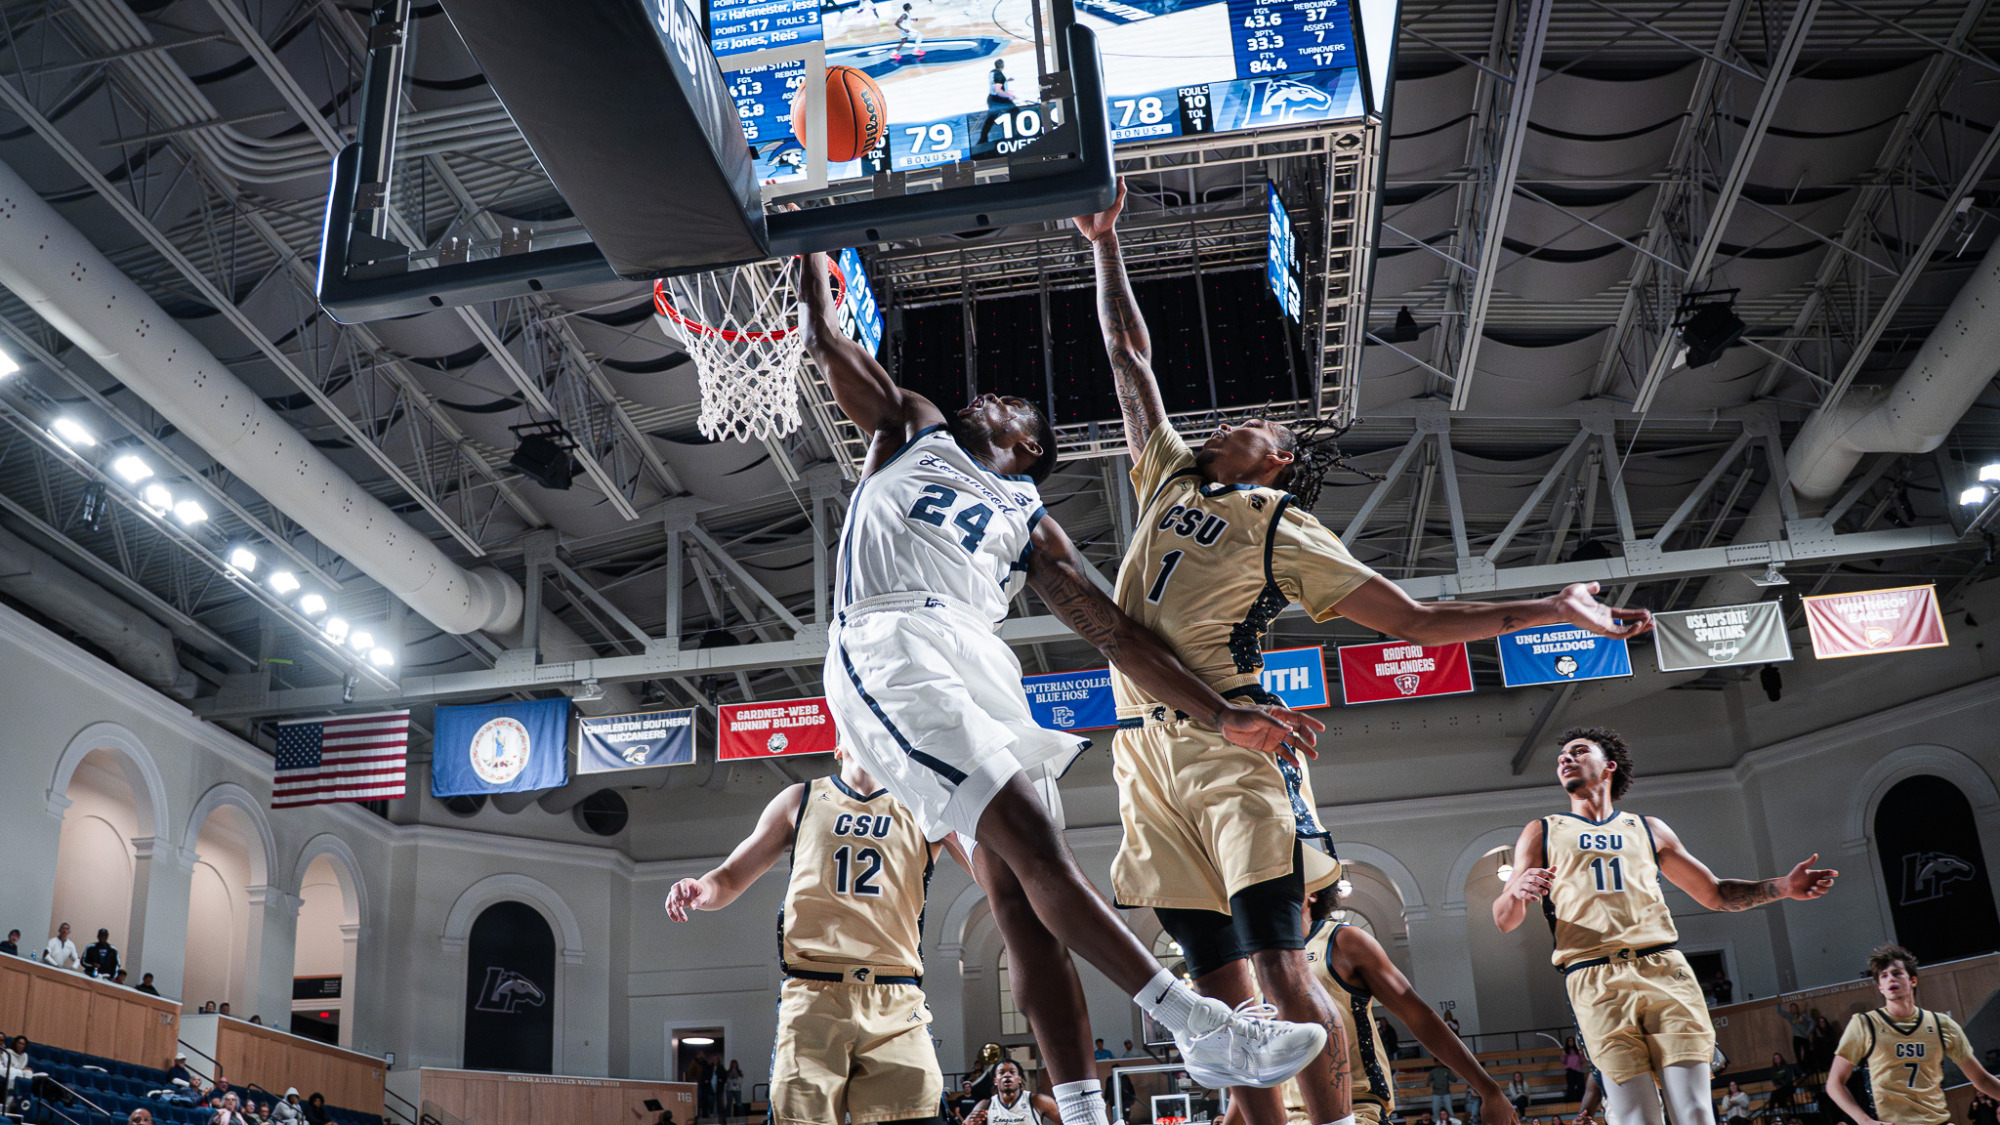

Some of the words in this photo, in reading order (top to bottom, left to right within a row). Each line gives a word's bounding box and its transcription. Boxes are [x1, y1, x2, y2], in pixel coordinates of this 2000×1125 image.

[714, 0, 743, 8] POINTS
[729, 3, 791, 20] Hafemeister,
[792, 0, 818, 12] Jesse
[1253, 7, 1270, 15] FG%
[1293, 0, 1337, 10] REBOUNDS
[1244, 13, 1282, 28] 43.6
[1305, 8, 1327, 21] 37
[715, 25, 747, 36] POINTS
[749, 19, 769, 32] 17
[776, 16, 805, 26] FOULS
[807, 11, 818, 24] 3
[1303, 22, 1334, 32] ASSISTS
[716, 42, 728, 50] 23
[731, 37, 768, 49] Jones,
[771, 30, 798, 42] Reis
[1247, 35, 1284, 51] 33.3
[1314, 31, 1325, 43] 7
[1298, 44, 1345, 55] TURNOVERS
[1249, 58, 1287, 73] 84.4
[1312, 53, 1334, 66] 17
[775, 69, 806, 79] REBOUN
[1178, 86, 1209, 97] FOULS
[1184, 96, 1206, 109] 10
[739, 104, 764, 118] 6.8
[1114, 97, 1164, 127] 78
[1187, 109, 1206, 118] TOL
[861, 90, 878, 153] Wilson
[1192, 119, 1202, 131] 1
[905, 124, 953, 154] 79
[867, 150, 885, 160] TOL
[871, 158, 881, 171] 1
[906, 484, 994, 555] 24
[1158, 504, 1229, 548] CSU
[1146, 549, 1185, 606] 1
[1834, 597, 1908, 615] WINTHROP
[1685, 614, 1707, 629] USC
[1706, 610, 1749, 627] UPSTATE
[1848, 609, 1900, 623] EAGLES
[1515, 633, 1541, 645] UNC
[1694, 625, 1746, 642] SPARTANS
[1382, 645, 1424, 661] RADFORD
[1532, 639, 1595, 655] BULLDOGS
[1375, 658, 1435, 677] HIGHLANDERS
[1035, 692, 1061, 704] BLUE
[1062, 689, 1089, 701] HOSE
[736, 704, 819, 721] GARDNER-WEBB
[584, 721, 641, 735] CHARLESTON
[642, 716, 691, 730] SOUTHERN
[730, 718, 772, 732] RUNNIN'
[773, 714, 826, 729] BULLDOGS
[607, 729, 667, 743] BUCCANEERS
[833, 813, 892, 839] CSU
[1578, 833, 1623, 850] CSU
[833, 845, 883, 897] 12
[1589, 856, 1625, 892] 11
[1896, 1042, 1925, 1058] CSU
[1904, 1062, 1920, 1089] 7
[677, 1092, 692, 1103] 116
